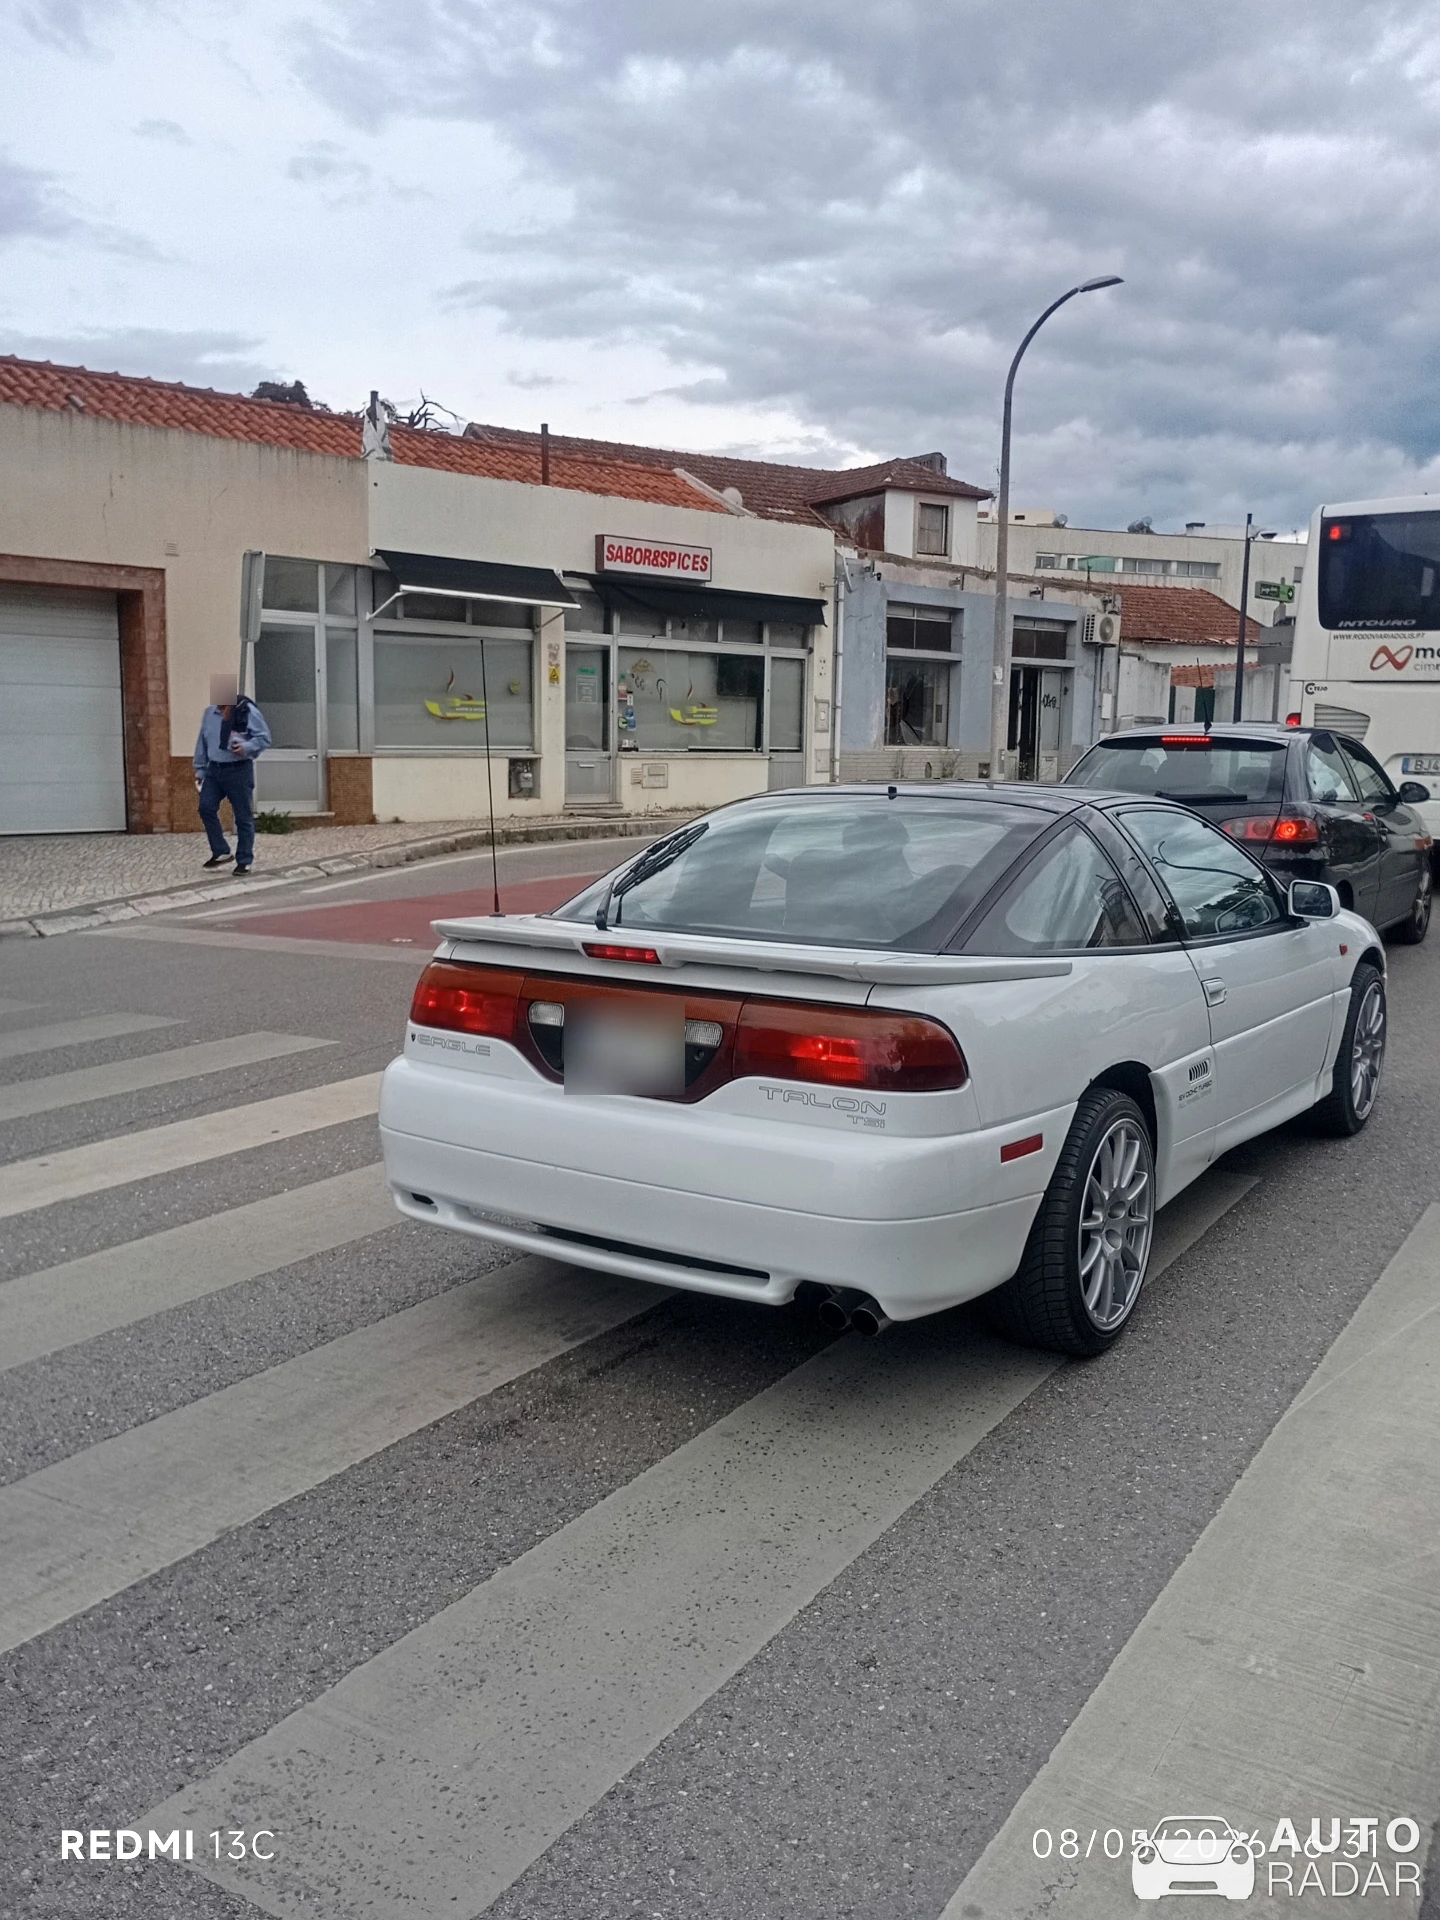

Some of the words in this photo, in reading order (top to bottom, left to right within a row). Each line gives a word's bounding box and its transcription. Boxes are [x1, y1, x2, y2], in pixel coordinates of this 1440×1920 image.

[606, 544, 709, 572] SABOR&SPICES
[417, 1034, 490, 1057] EAGLE
[759, 1086, 887, 1115] TALON
